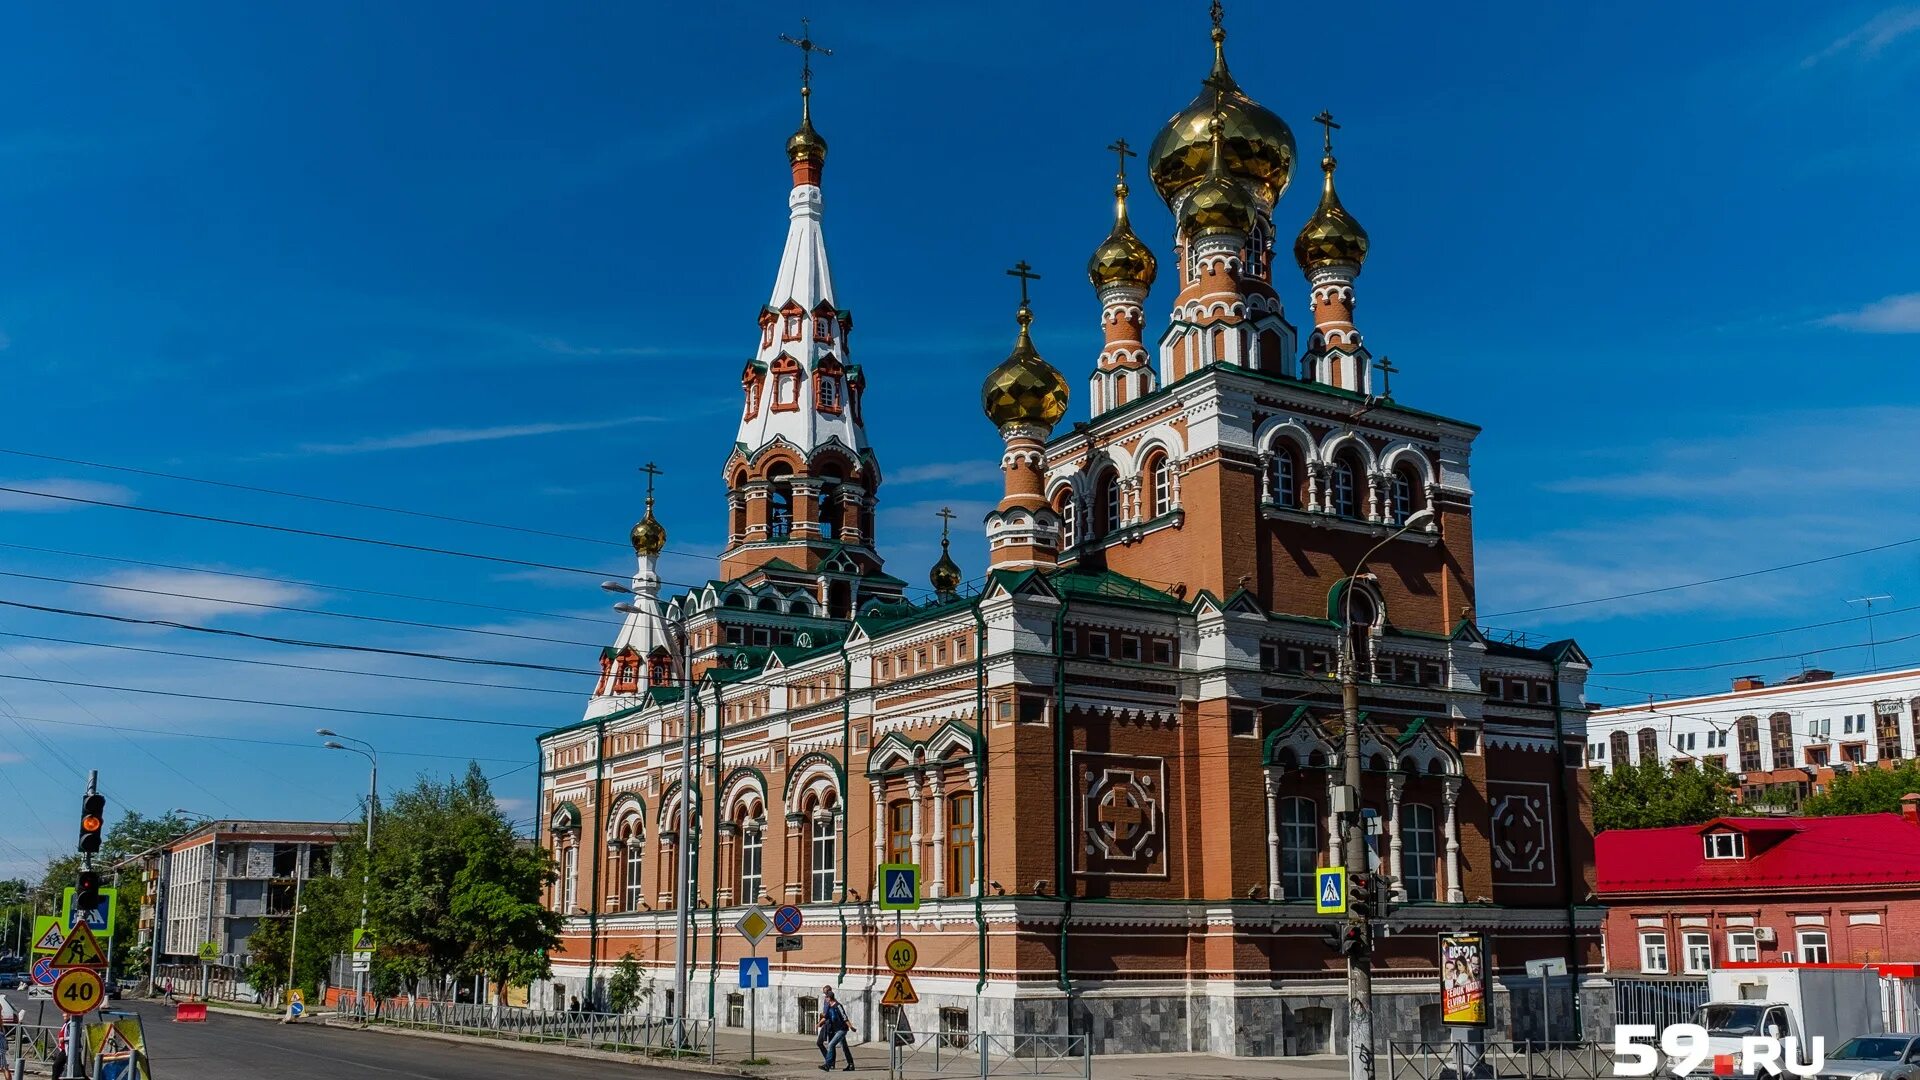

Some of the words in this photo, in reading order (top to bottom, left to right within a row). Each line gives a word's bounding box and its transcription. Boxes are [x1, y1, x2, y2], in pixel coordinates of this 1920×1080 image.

[893, 949, 910, 963] 40
[64, 983, 93, 1001] 40
[1447, 995, 1465, 1009] ELVIRA
